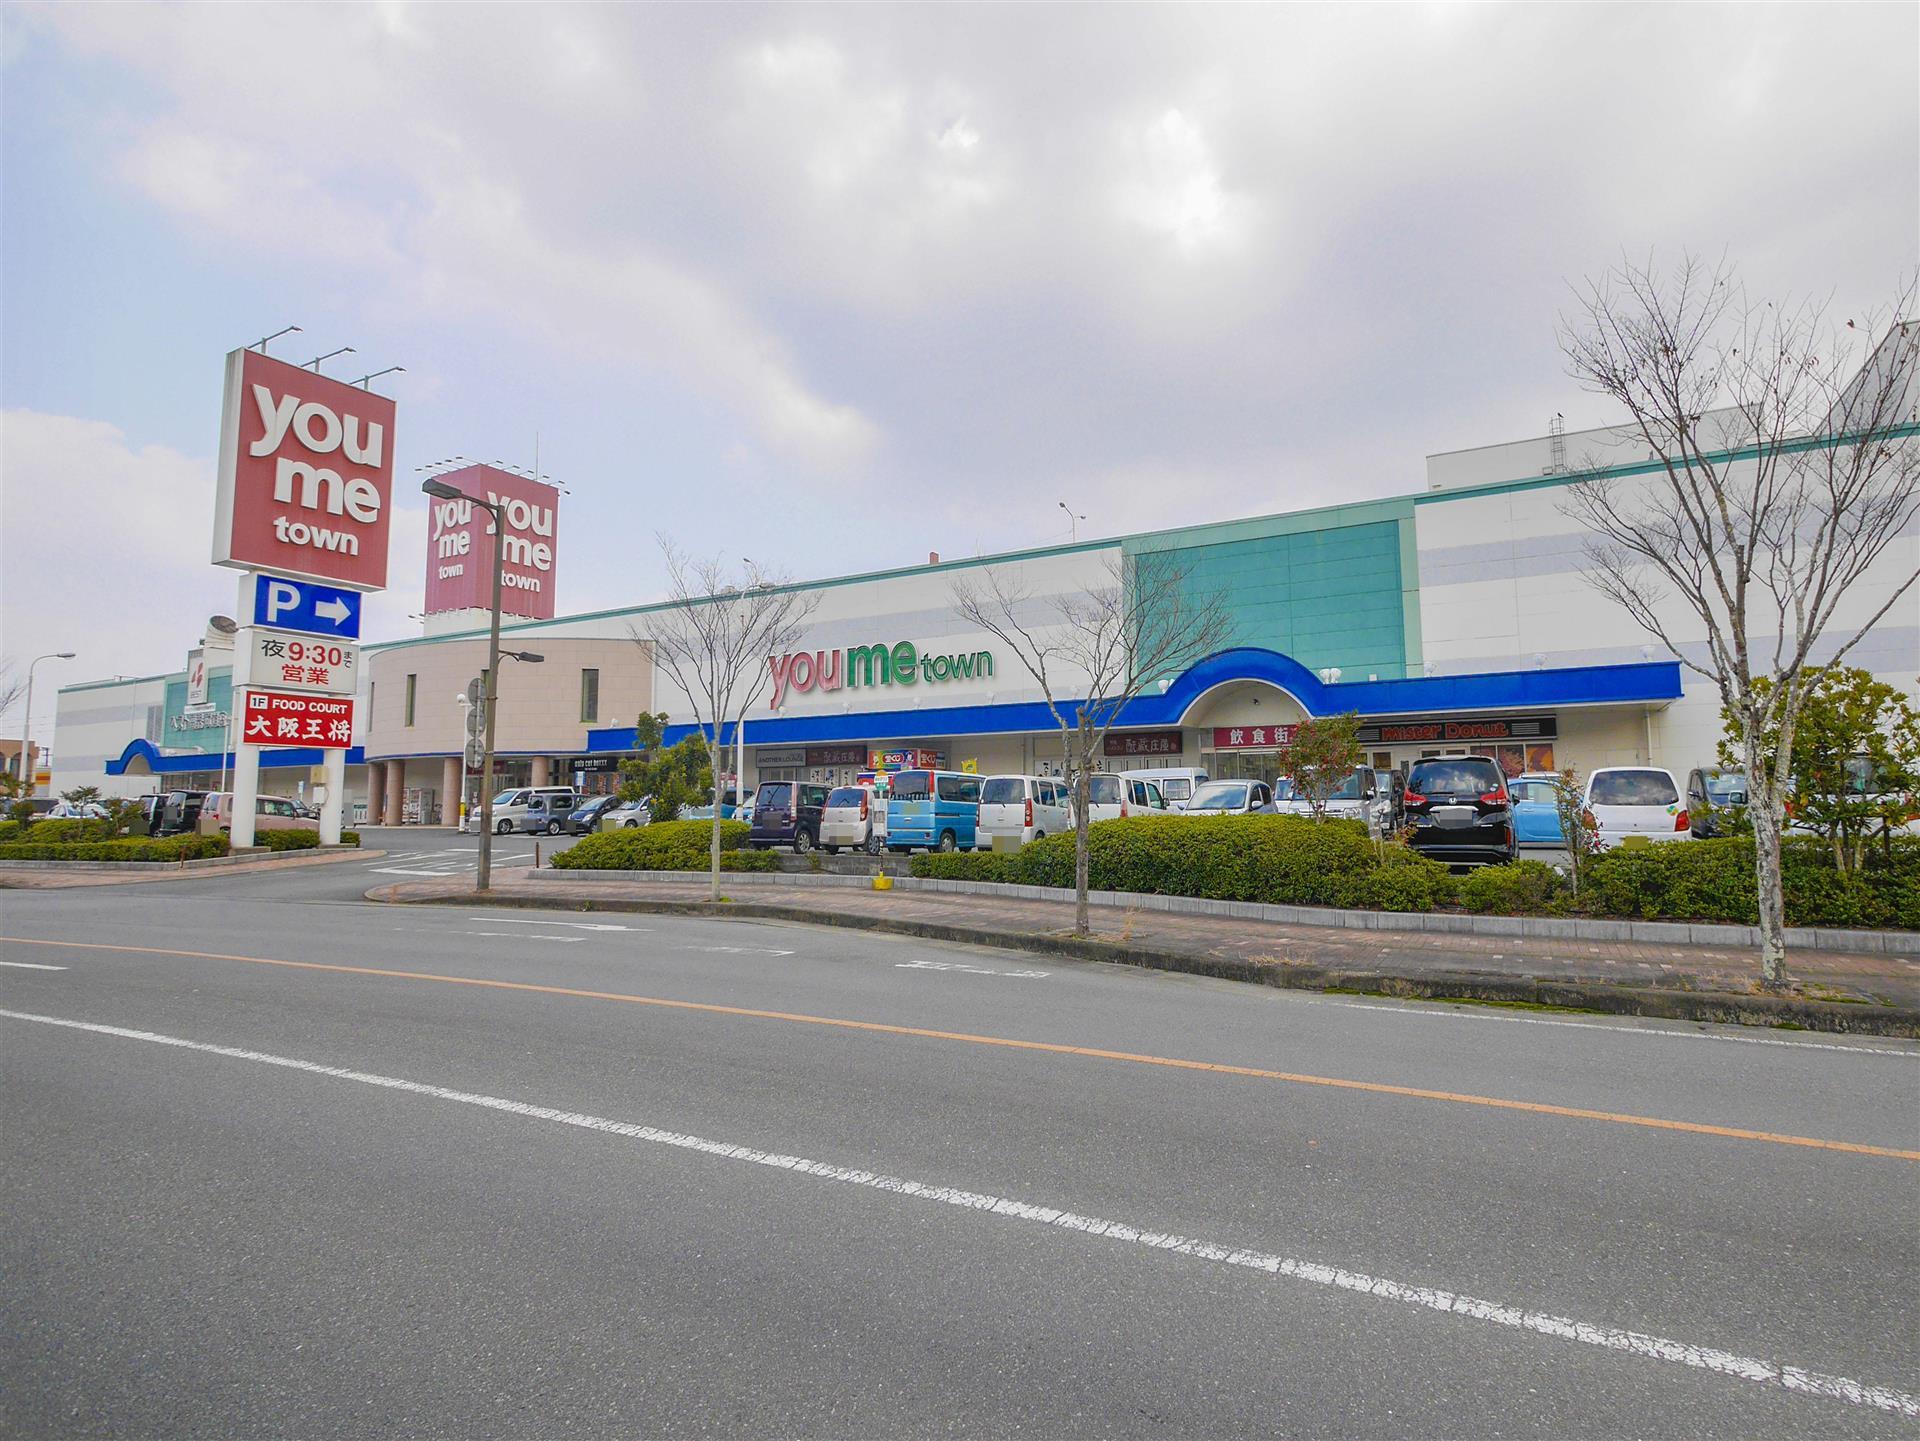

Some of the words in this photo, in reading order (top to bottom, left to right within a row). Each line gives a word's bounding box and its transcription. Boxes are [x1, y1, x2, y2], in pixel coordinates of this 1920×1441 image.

[250, 384, 383, 469] you
[274, 457, 381, 524] me
[433, 499, 472, 541] you
[486, 491, 553, 537] you
[273, 516, 359, 556] town
[439, 530, 471, 559] me
[502, 534, 552, 571] me
[438, 564, 464, 580] town
[501, 569, 541, 593] town
[267, 581, 301, 622] P
[281, 664, 329, 685] 営業
[920, 649, 995, 683] town
[252, 697, 266, 708] 1F
[272, 699, 306, 711] FOOD
[308, 702, 348, 714] COURT
[246, 715, 352, 742] 大阪王将
[1230, 727, 1289, 745] 飲食街
[1445, 722, 1508, 739] Donut
